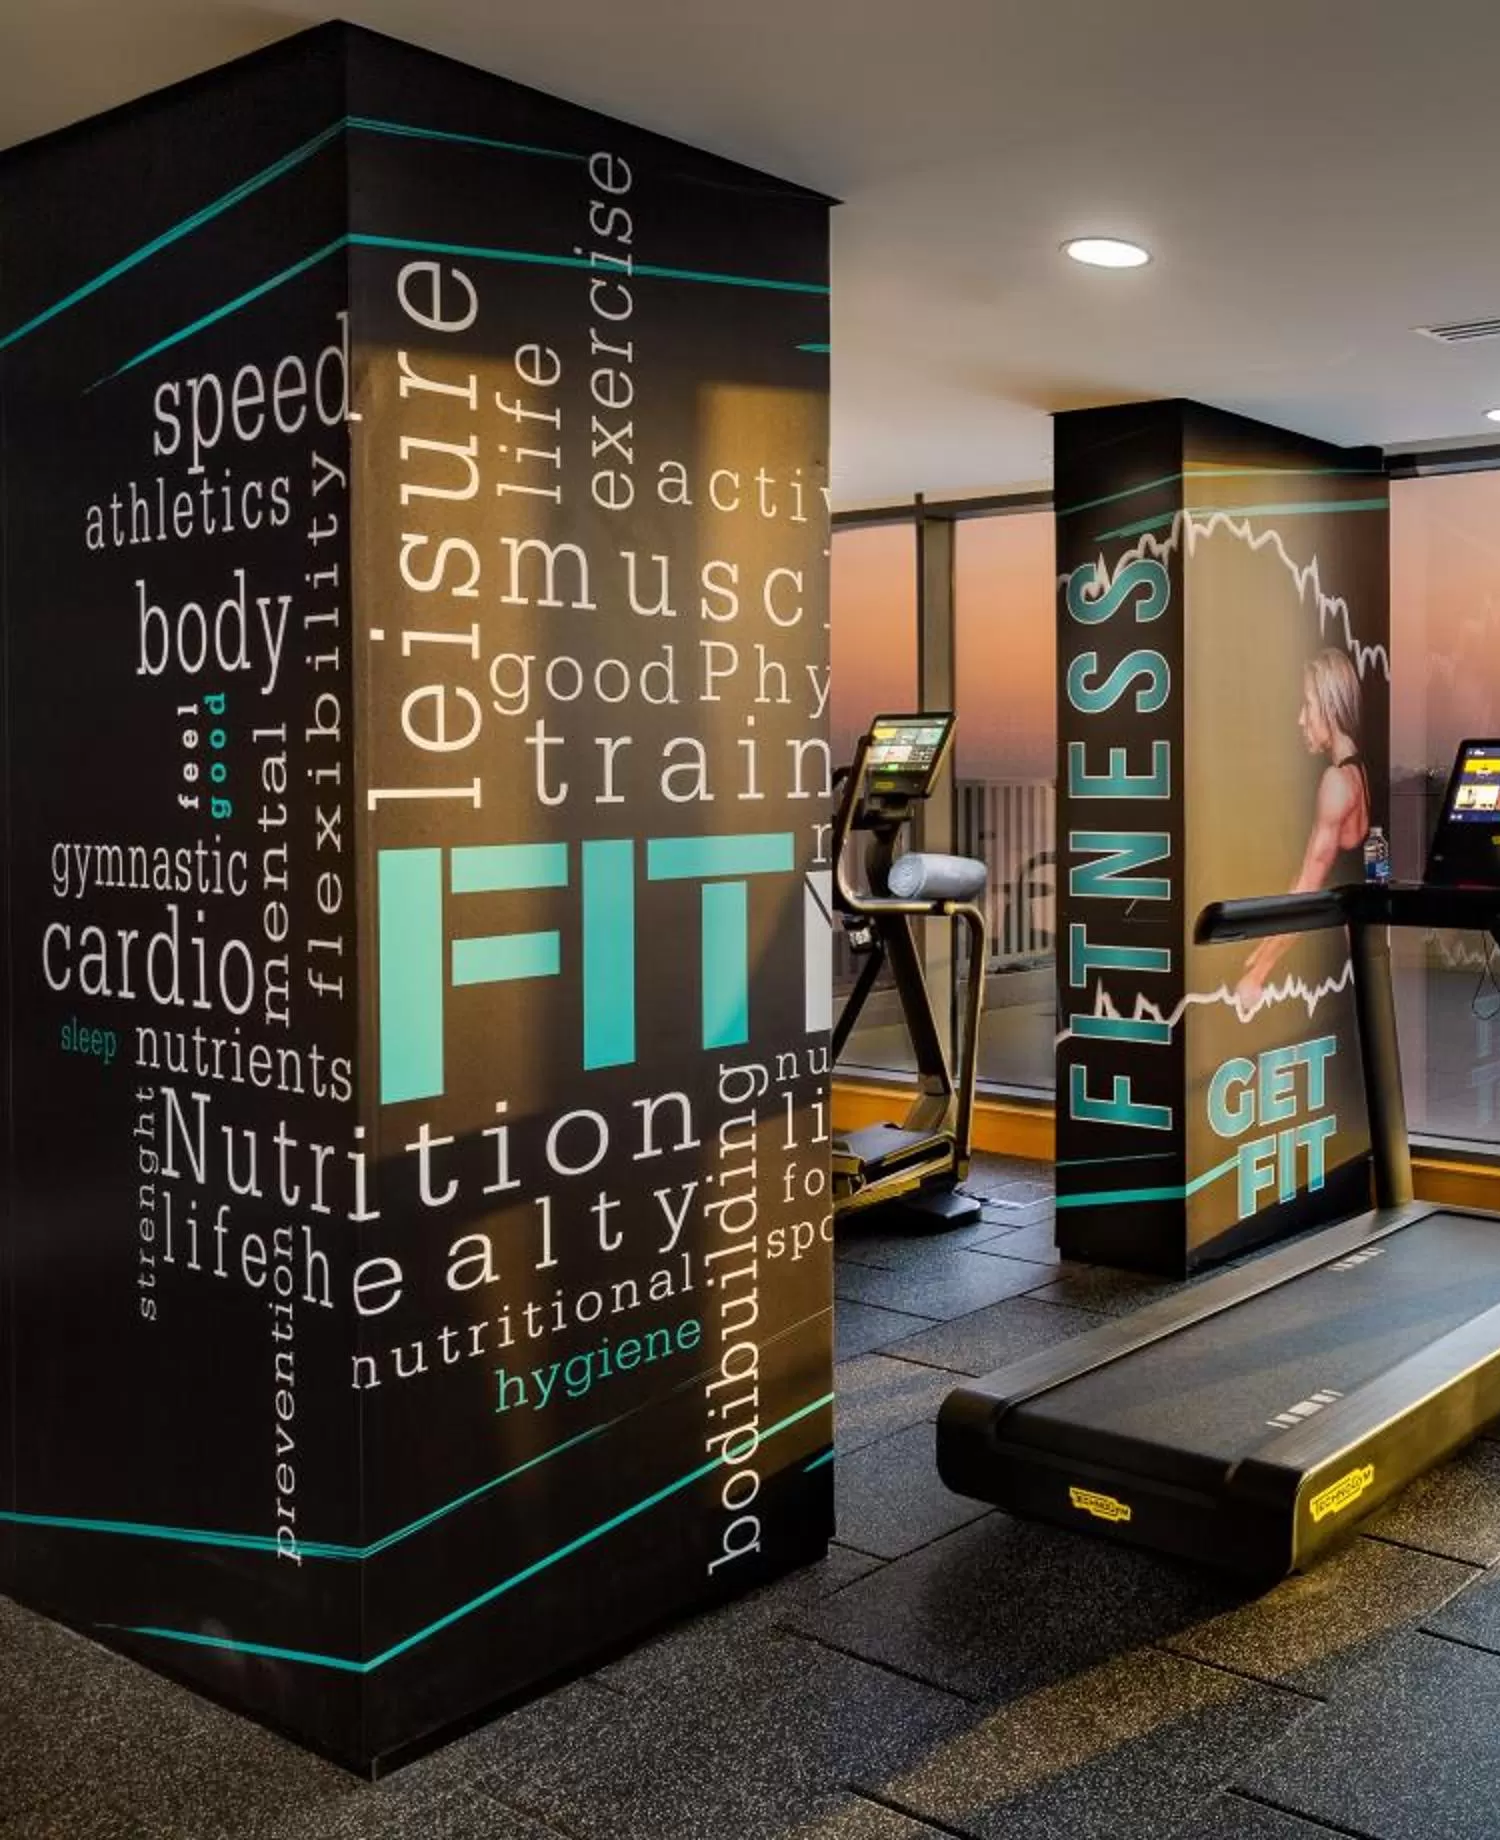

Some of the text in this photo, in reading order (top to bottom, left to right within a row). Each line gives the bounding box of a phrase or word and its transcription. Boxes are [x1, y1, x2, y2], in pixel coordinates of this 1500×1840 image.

[154, 311, 363, 476] speed
[574, 150, 634, 511] exercise
[496, 342, 561, 505] life
[85, 468, 292, 550] athletics
[367, 259, 483, 811] leisure
[135, 569, 293, 695] body
[500, 535, 832, 630] musc
[177, 703, 199, 809] feel
[204, 692, 232, 819] good
[304, 451, 346, 1001] flexibility
[525, 716, 832, 806] train
[51, 835, 248, 899] gymnastic
[252, 722, 290, 1029] mental
[1067, 557, 1172, 1131] FITNESS
[42, 903, 256, 1016] cardio
[60, 1015, 118, 1065] sleep
[135, 1026, 353, 1102] nutrients
[1207, 1035, 1337, 1138] GET
[133, 1086, 160, 1321] strenght
[160, 1085, 702, 1222] Nutrition
[1238, 1114, 1337, 1221] FIT
[162, 1190, 268, 1288] life
[301, 1180, 700, 1316] healty
[351, 1253, 696, 1389] nutritional
[495, 1318, 701, 1412] hygiene
[704, 1063, 769, 1576] bodibuilding
[267, 1225, 302, 1567] prevention
